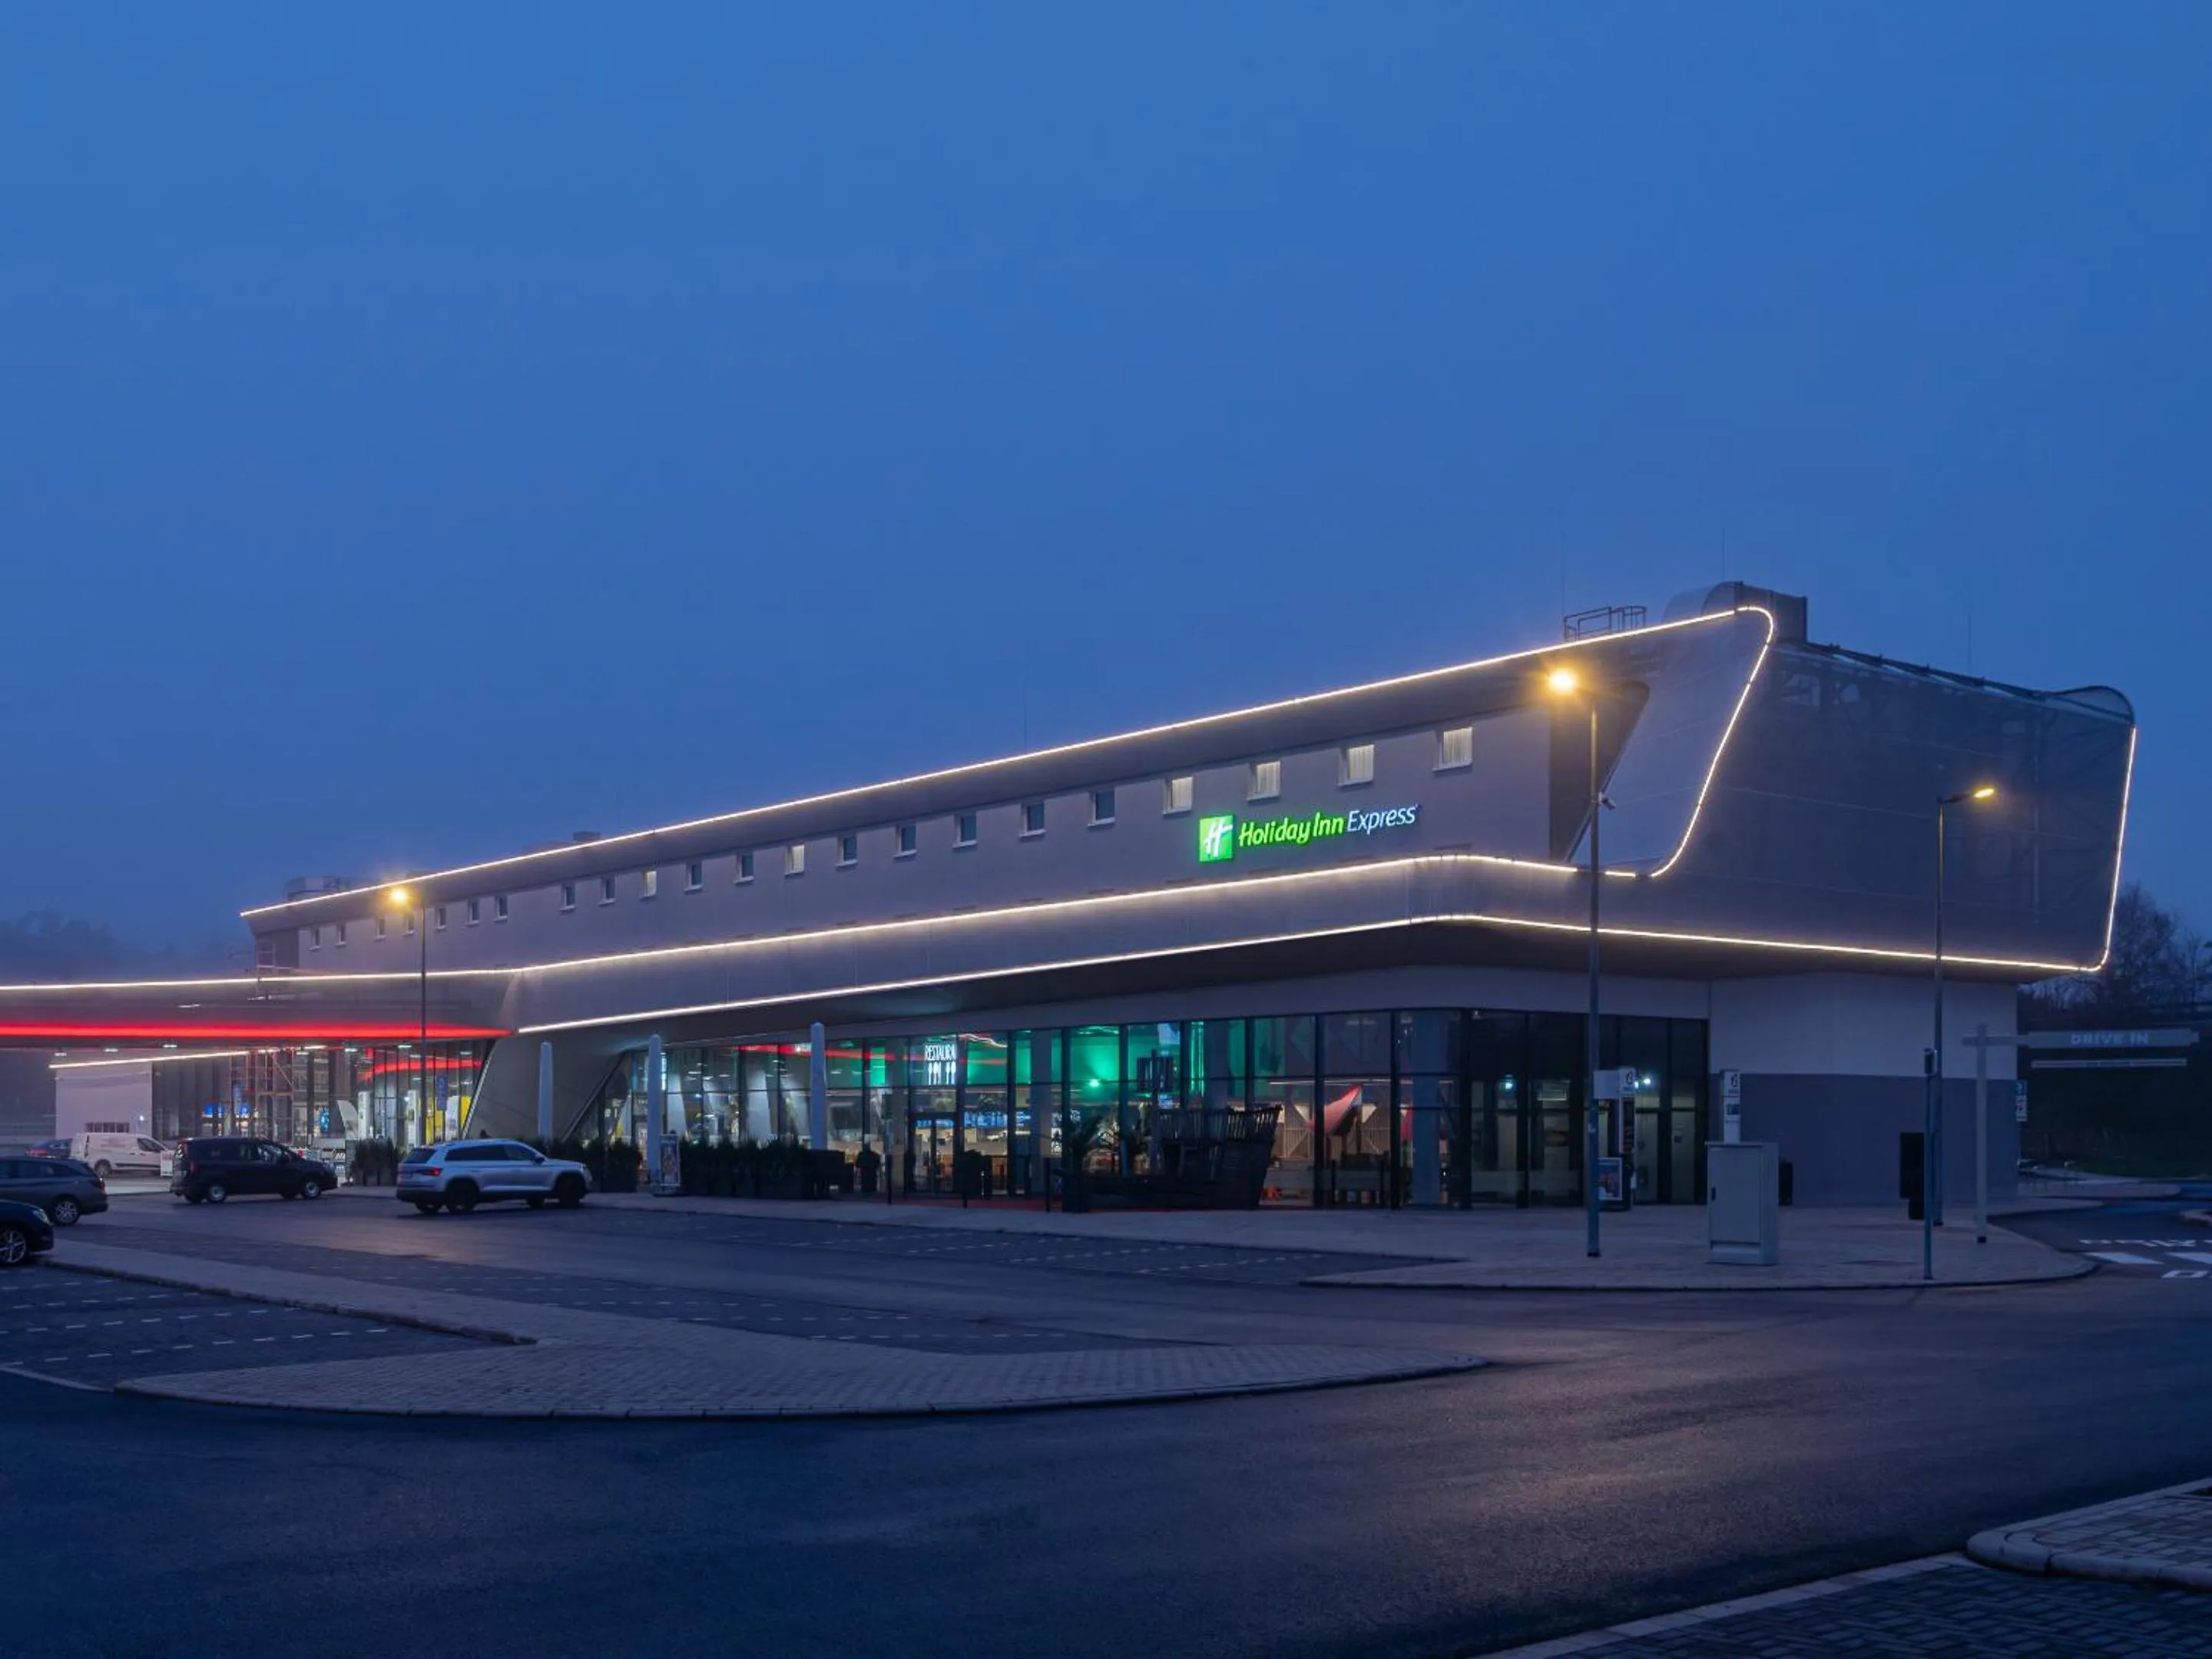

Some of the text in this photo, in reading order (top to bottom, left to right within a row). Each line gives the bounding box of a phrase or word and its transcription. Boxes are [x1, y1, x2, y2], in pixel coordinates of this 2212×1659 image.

[1238, 816, 1311, 847] Holiday
[1313, 810, 1344, 837] Inn
[1346, 806, 1416, 835] Express
[2070, 1031, 2149, 1046] DRIVE IN
[924, 1044, 957, 1061] RESTAURA
